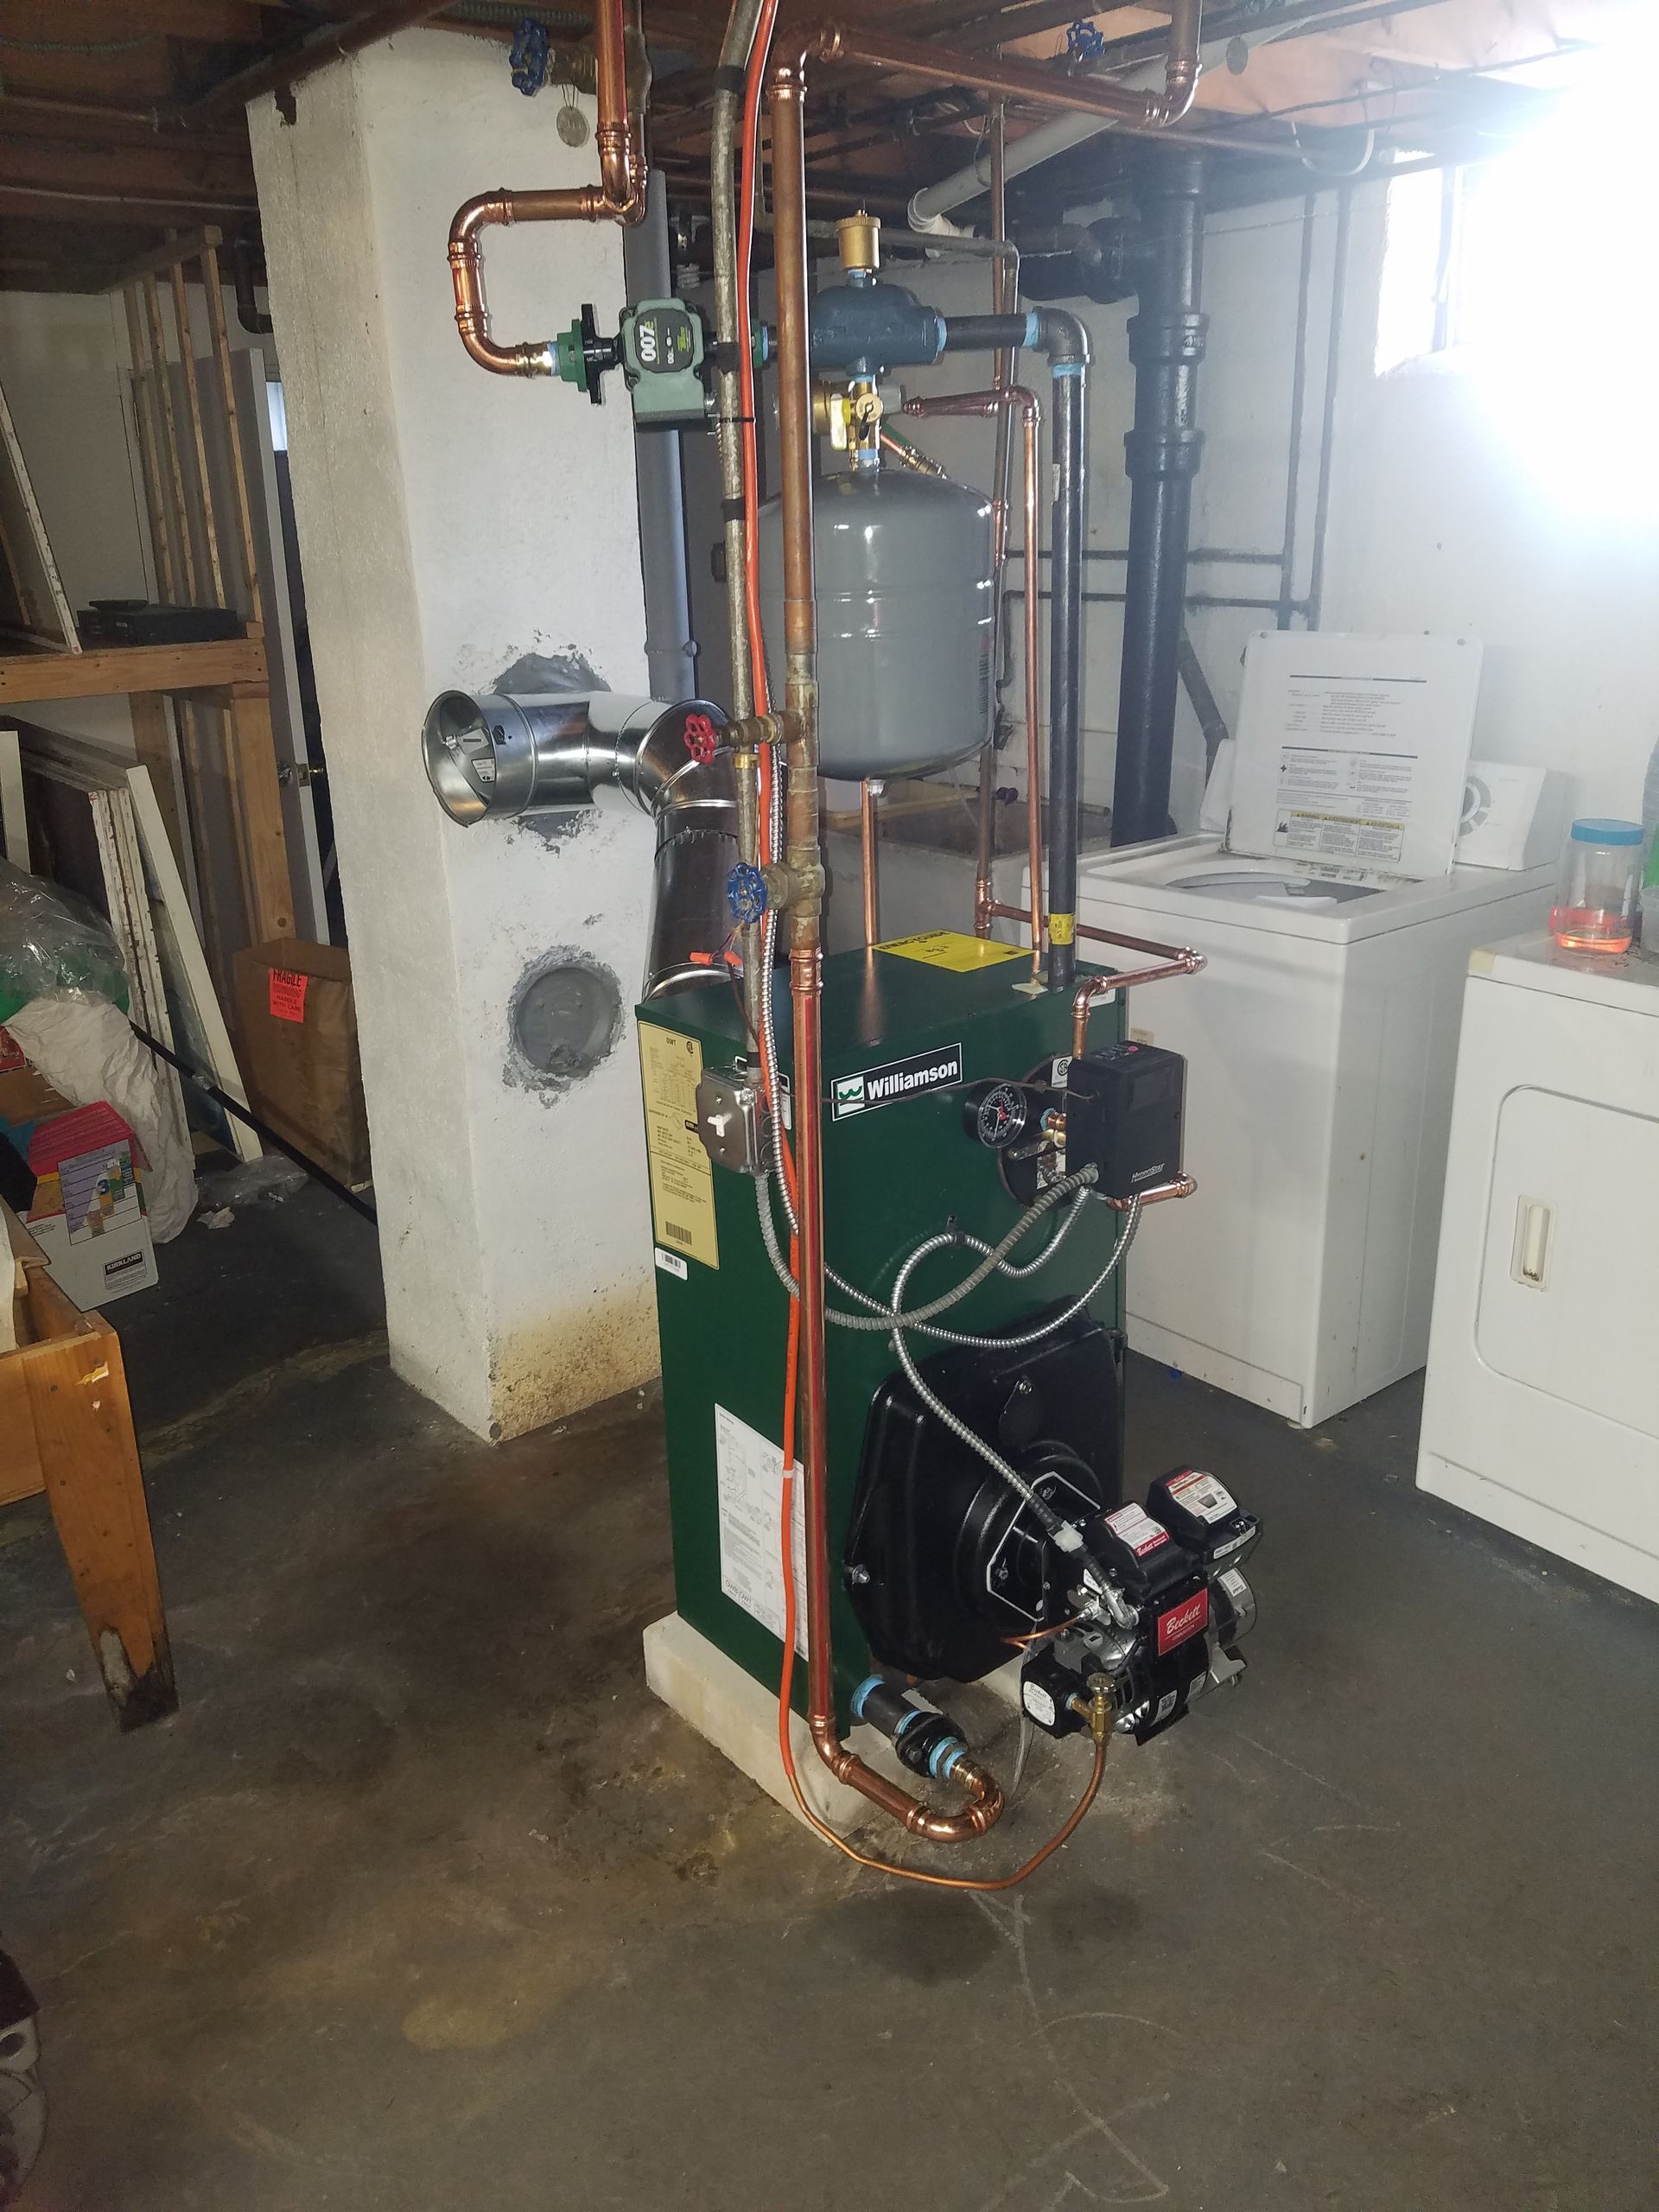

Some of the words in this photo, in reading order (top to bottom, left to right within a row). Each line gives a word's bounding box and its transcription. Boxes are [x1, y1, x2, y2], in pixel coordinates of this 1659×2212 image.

[273, 969, 302, 987] FRAGILE
[867, 1060, 958, 1100] Williamson
[106, 1253, 142, 1271] KIRKLAND
[1166, 1604, 1201, 1634] Beckett
